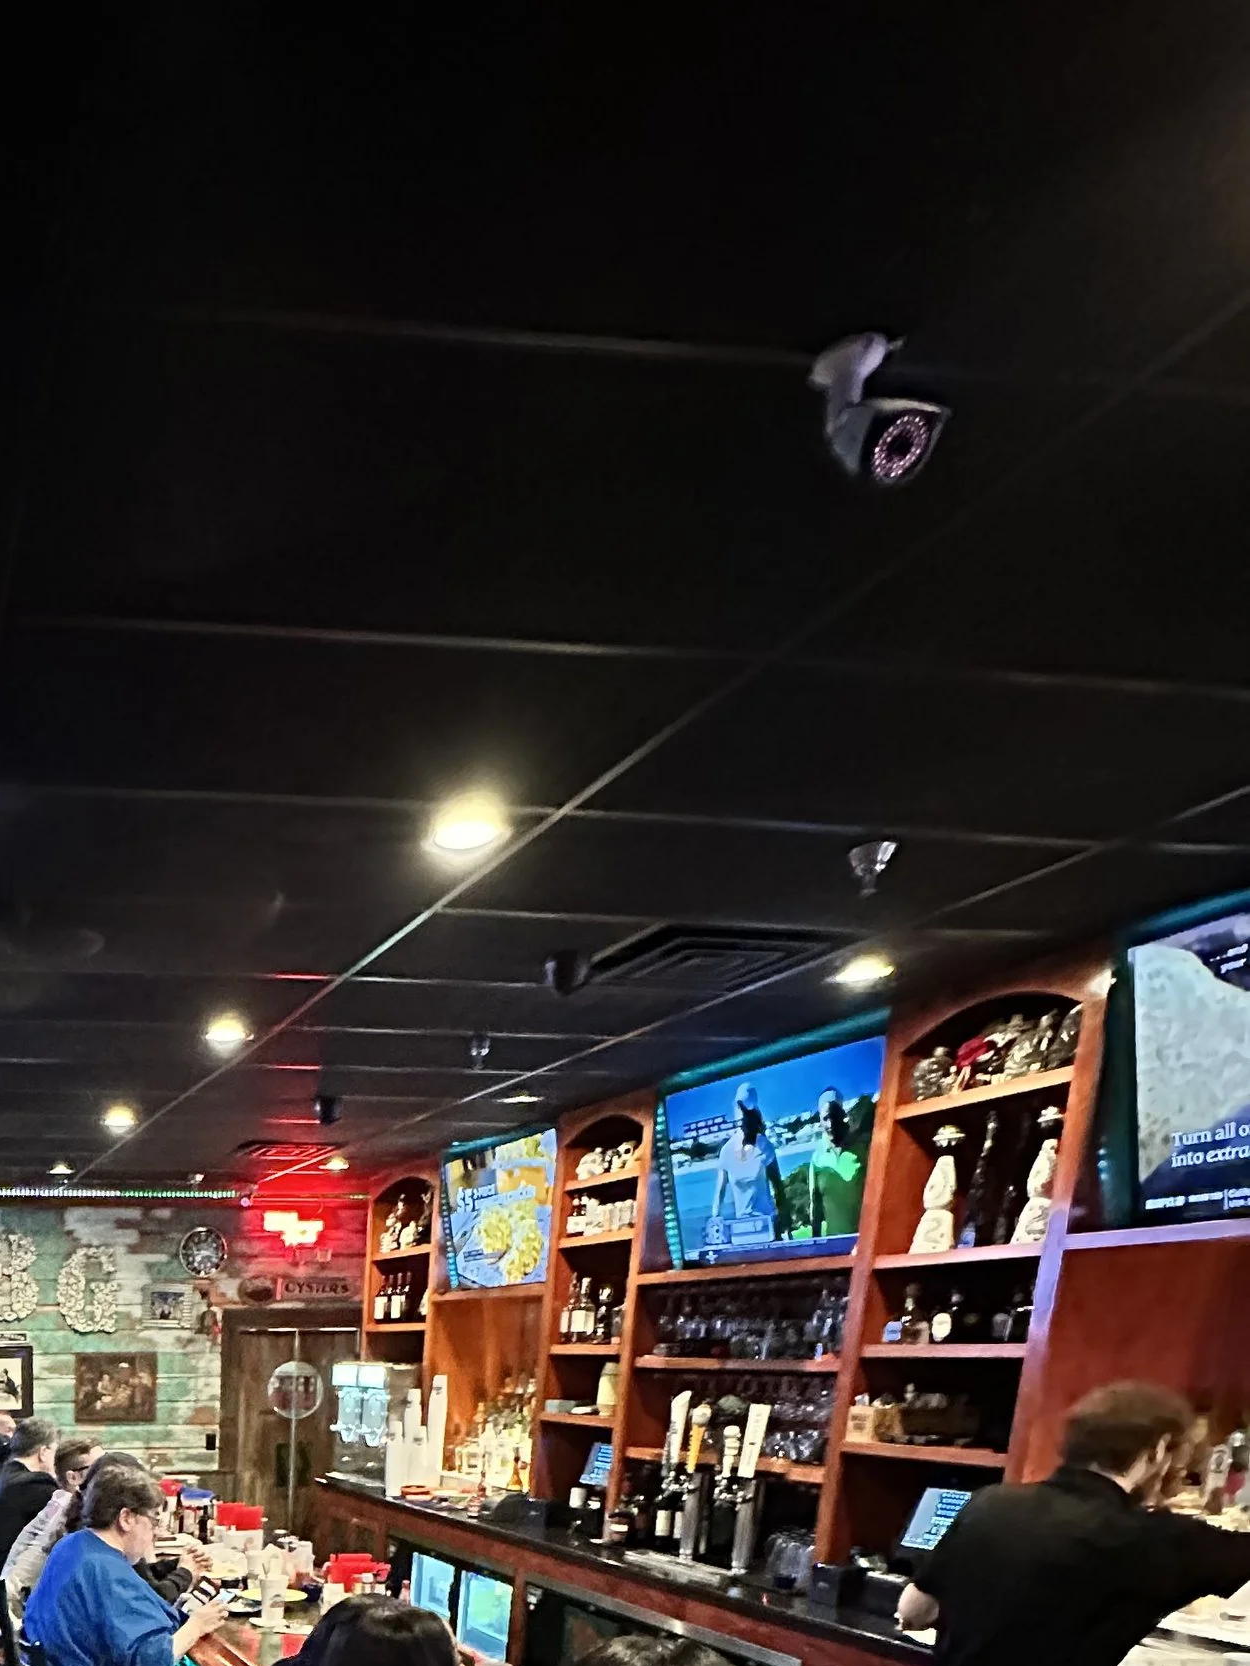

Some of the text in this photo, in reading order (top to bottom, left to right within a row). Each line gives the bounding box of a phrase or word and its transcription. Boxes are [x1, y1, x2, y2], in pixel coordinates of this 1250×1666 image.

[1171, 1131, 1213, 1147] Turn
[1214, 1121, 1237, 1141] all
[1171, 1151, 1205, 1168] into
